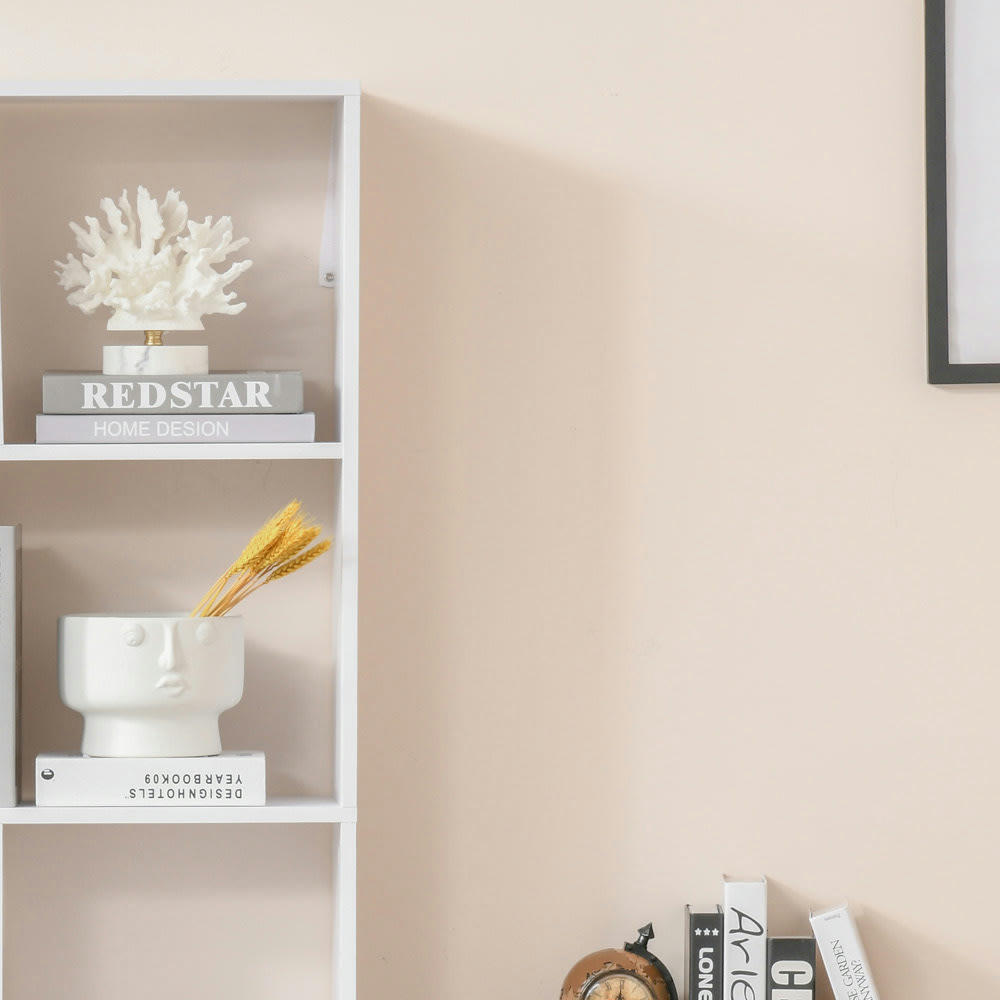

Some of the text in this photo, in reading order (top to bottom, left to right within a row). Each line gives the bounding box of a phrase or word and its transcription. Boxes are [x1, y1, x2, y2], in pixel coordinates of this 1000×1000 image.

[81, 381, 272, 410] REDSTAR
[94, 421, 151, 437] HOME
[144, 774, 243, 784] YEARBOOK09
[830, 938, 854, 988] GARDEN
